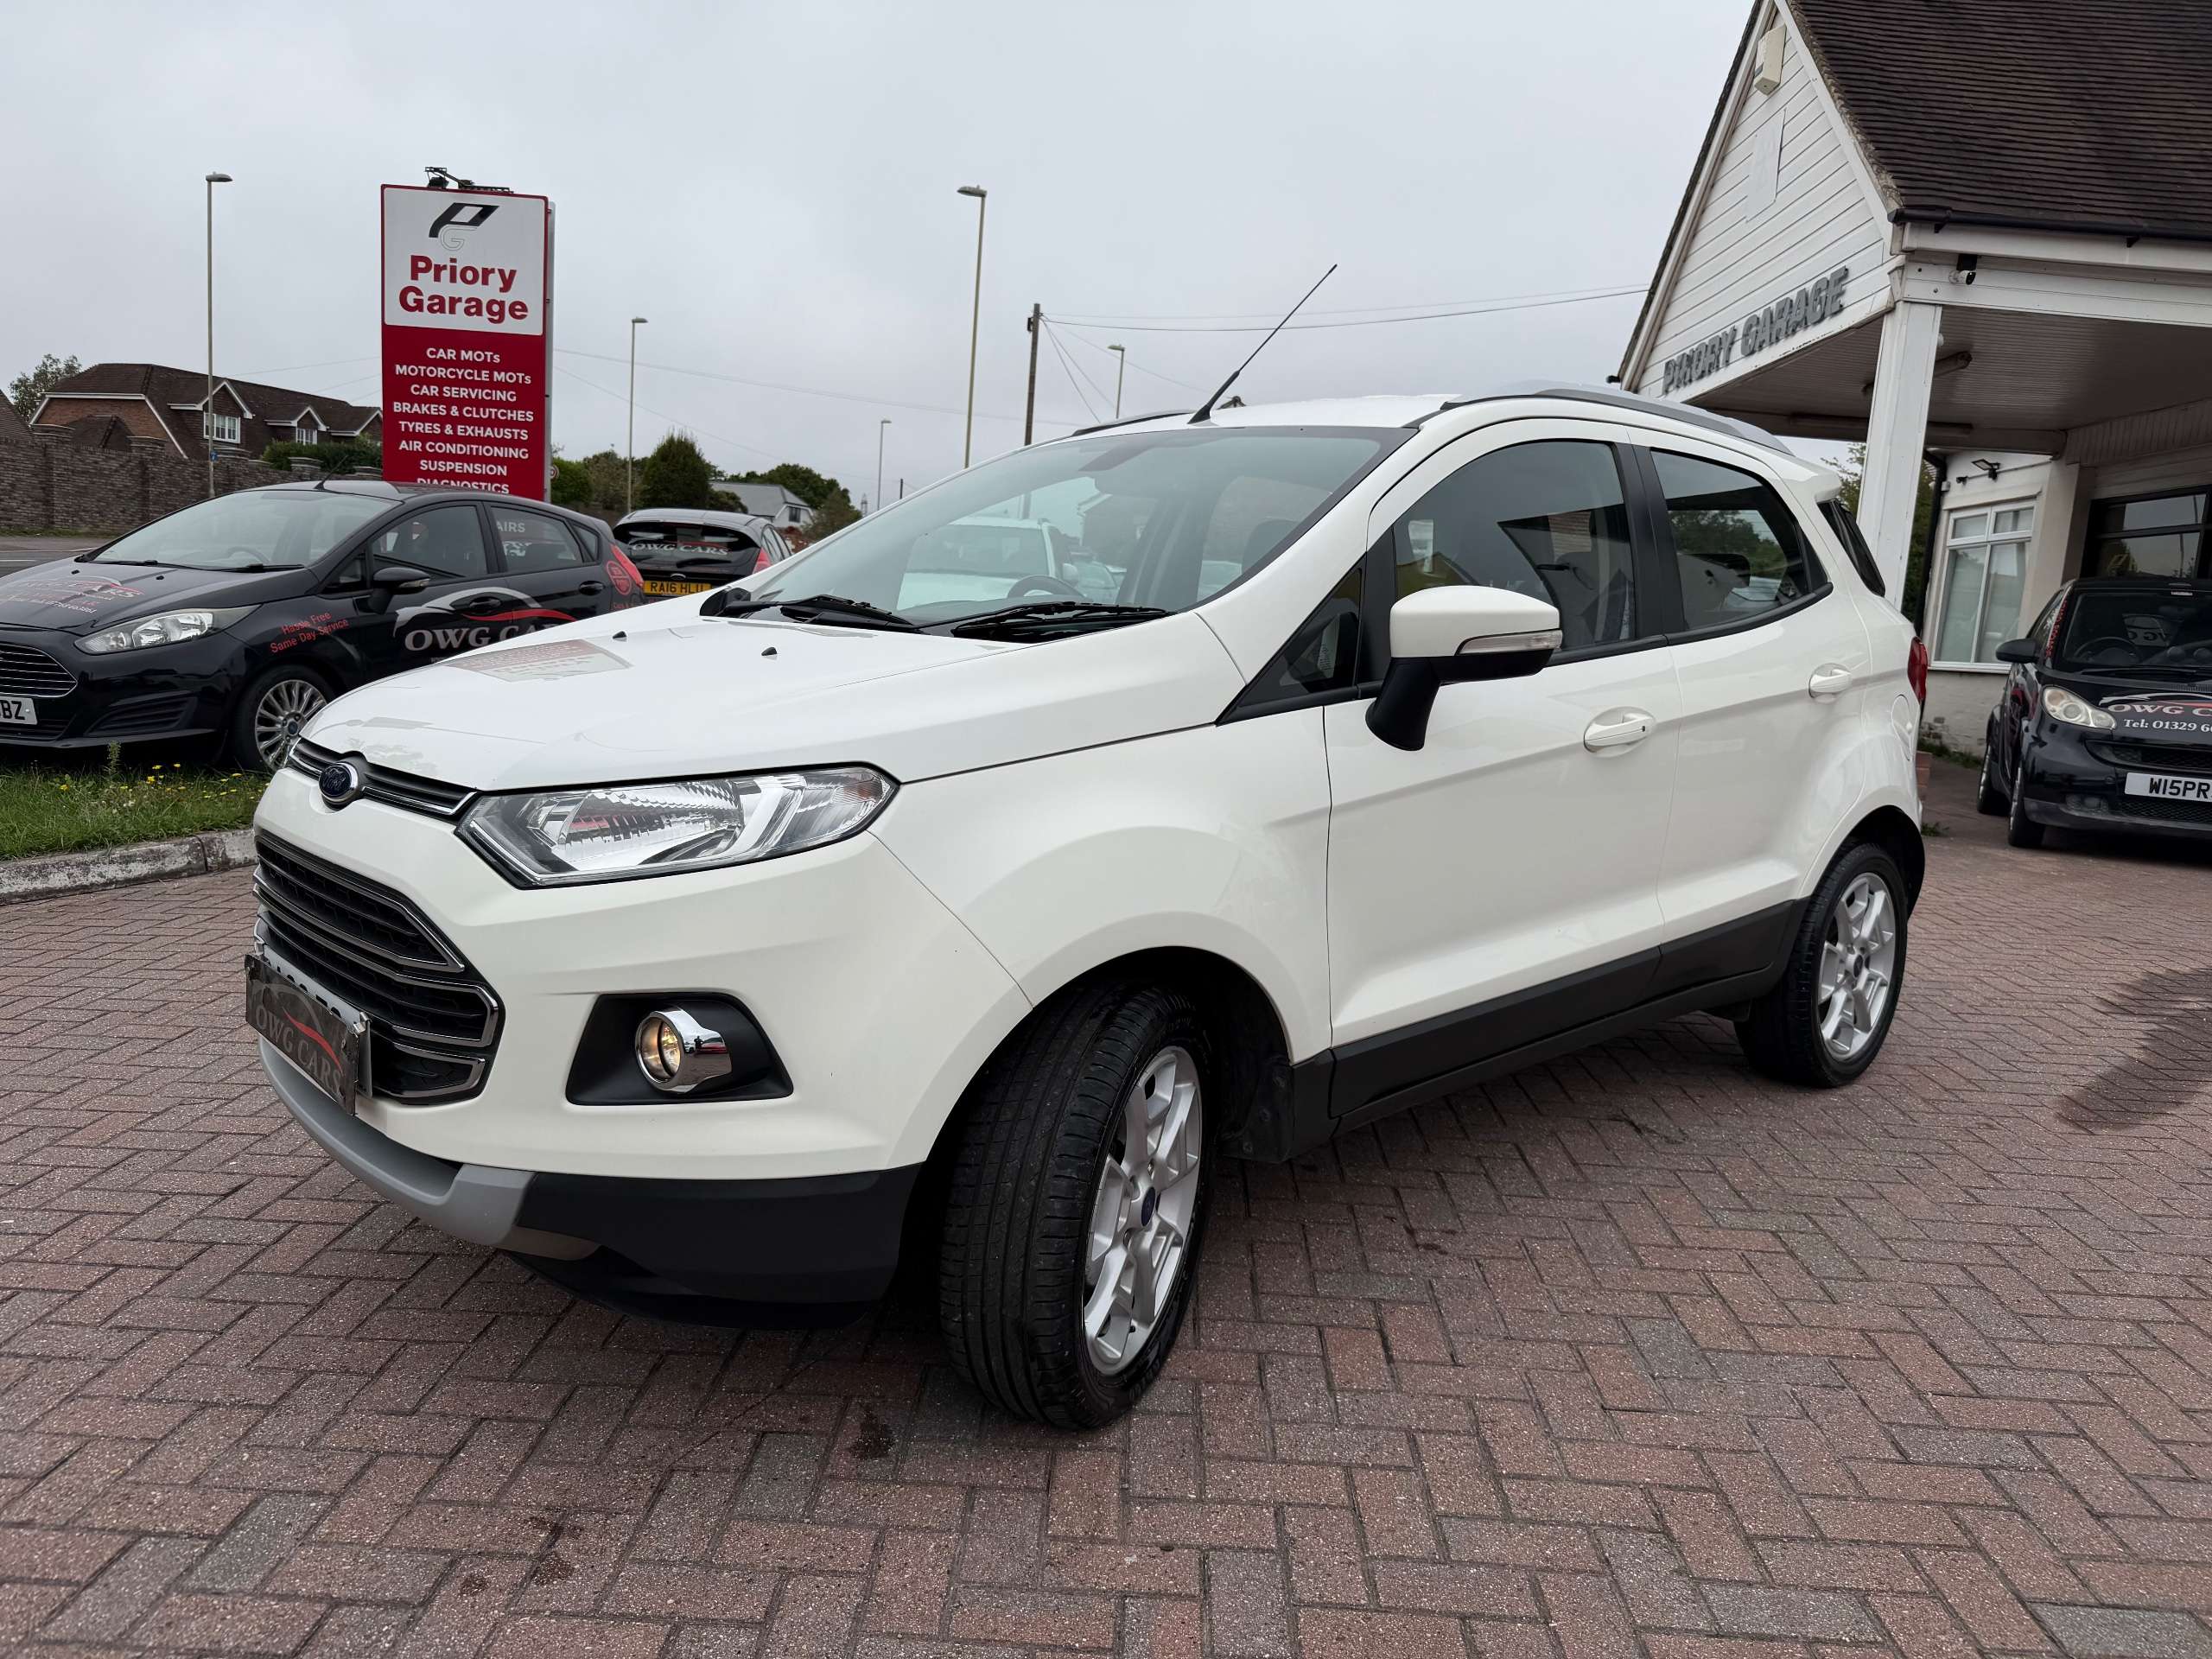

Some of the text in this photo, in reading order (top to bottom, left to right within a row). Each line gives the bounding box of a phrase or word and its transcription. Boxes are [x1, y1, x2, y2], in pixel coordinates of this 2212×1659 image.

[410, 255, 517, 293] Priory
[398, 285, 529, 324] Garage
[1662, 265, 1849, 393] PRIORY GARAGE
[426, 347, 500, 363] CAR MOTs
[395, 364, 531, 385] MOTORCYCLE MOTs
[410, 384, 517, 402] CAR SERVICING
[393, 402, 534, 422] BRAKES & CLUTCHES
[398, 421, 528, 441] TYRES & EXHAUSTS
[398, 440, 529, 459] AIR CONDITIONING
[420, 460, 507, 476] SUSPENSION
[632, 543, 728, 556] OWG CARS
[650, 582, 677, 594] RA16
[310, 612, 332, 623] Free
[270, 620, 349, 652] Same Day Service
[404, 626, 492, 651] OWG
[0, 700, 26, 720] BZ
[2108, 703, 2184, 714] OWG
[2123, 719, 2149, 728] Tel:
[2152, 721, 2196, 731] 01329
[2149, 778, 2212, 799] W15PR
[256, 1005, 345, 1101] OWG CARS
